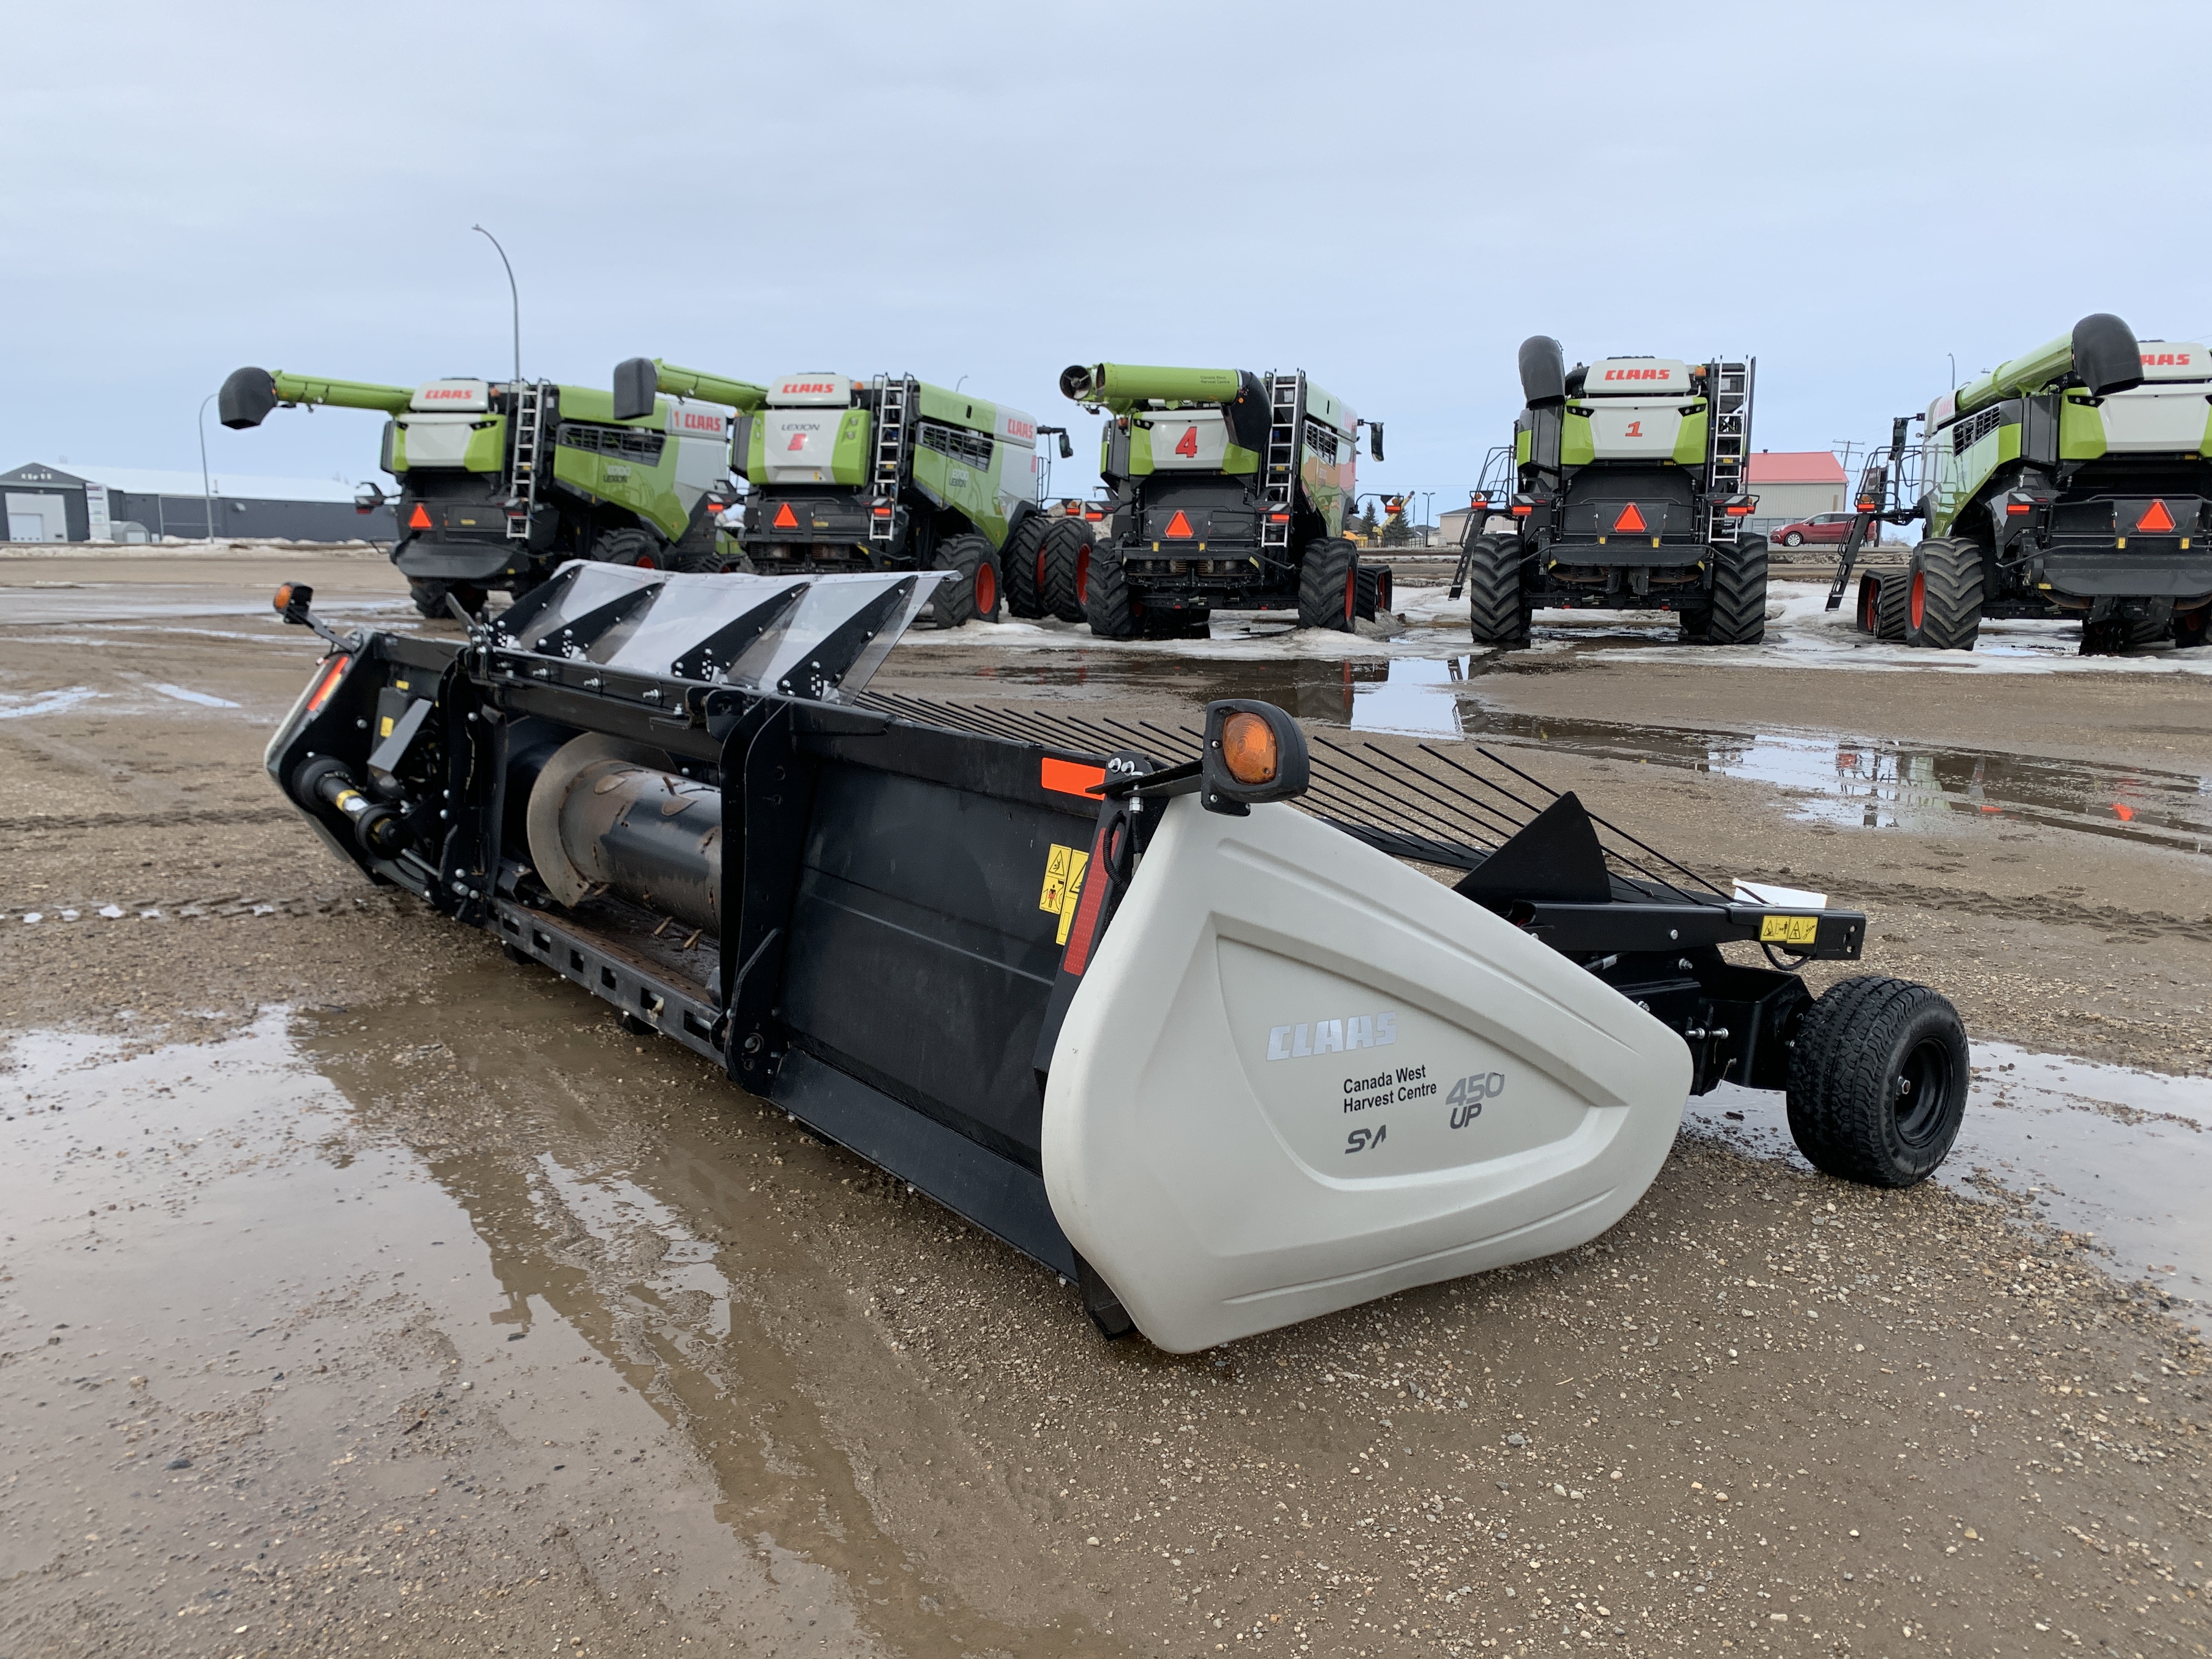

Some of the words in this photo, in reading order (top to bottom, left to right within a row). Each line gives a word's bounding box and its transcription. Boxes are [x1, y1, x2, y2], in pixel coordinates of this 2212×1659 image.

[2140, 354, 2191, 366] AAS
[1604, 369, 1671, 381] CLAAS
[425, 389, 473, 400] CLAAS
[782, 383, 835, 394] CLAAS
[685, 413, 721, 432] CLAAS
[1007, 418, 1033, 440] CLAAS
[1625, 421, 1643, 437] 1
[1175, 426, 1198, 458] 4
[1266, 1011, 1397, 1062] CLAAS
[1344, 1072, 1393, 1093] Canada
[1396, 1064, 1426, 1084] West
[1445, 1071, 1505, 1107] 450
[1344, 1090, 1395, 1114] Harvest
[1398, 1082, 1437, 1102] Centre
[1450, 1103, 1482, 1130] UP
